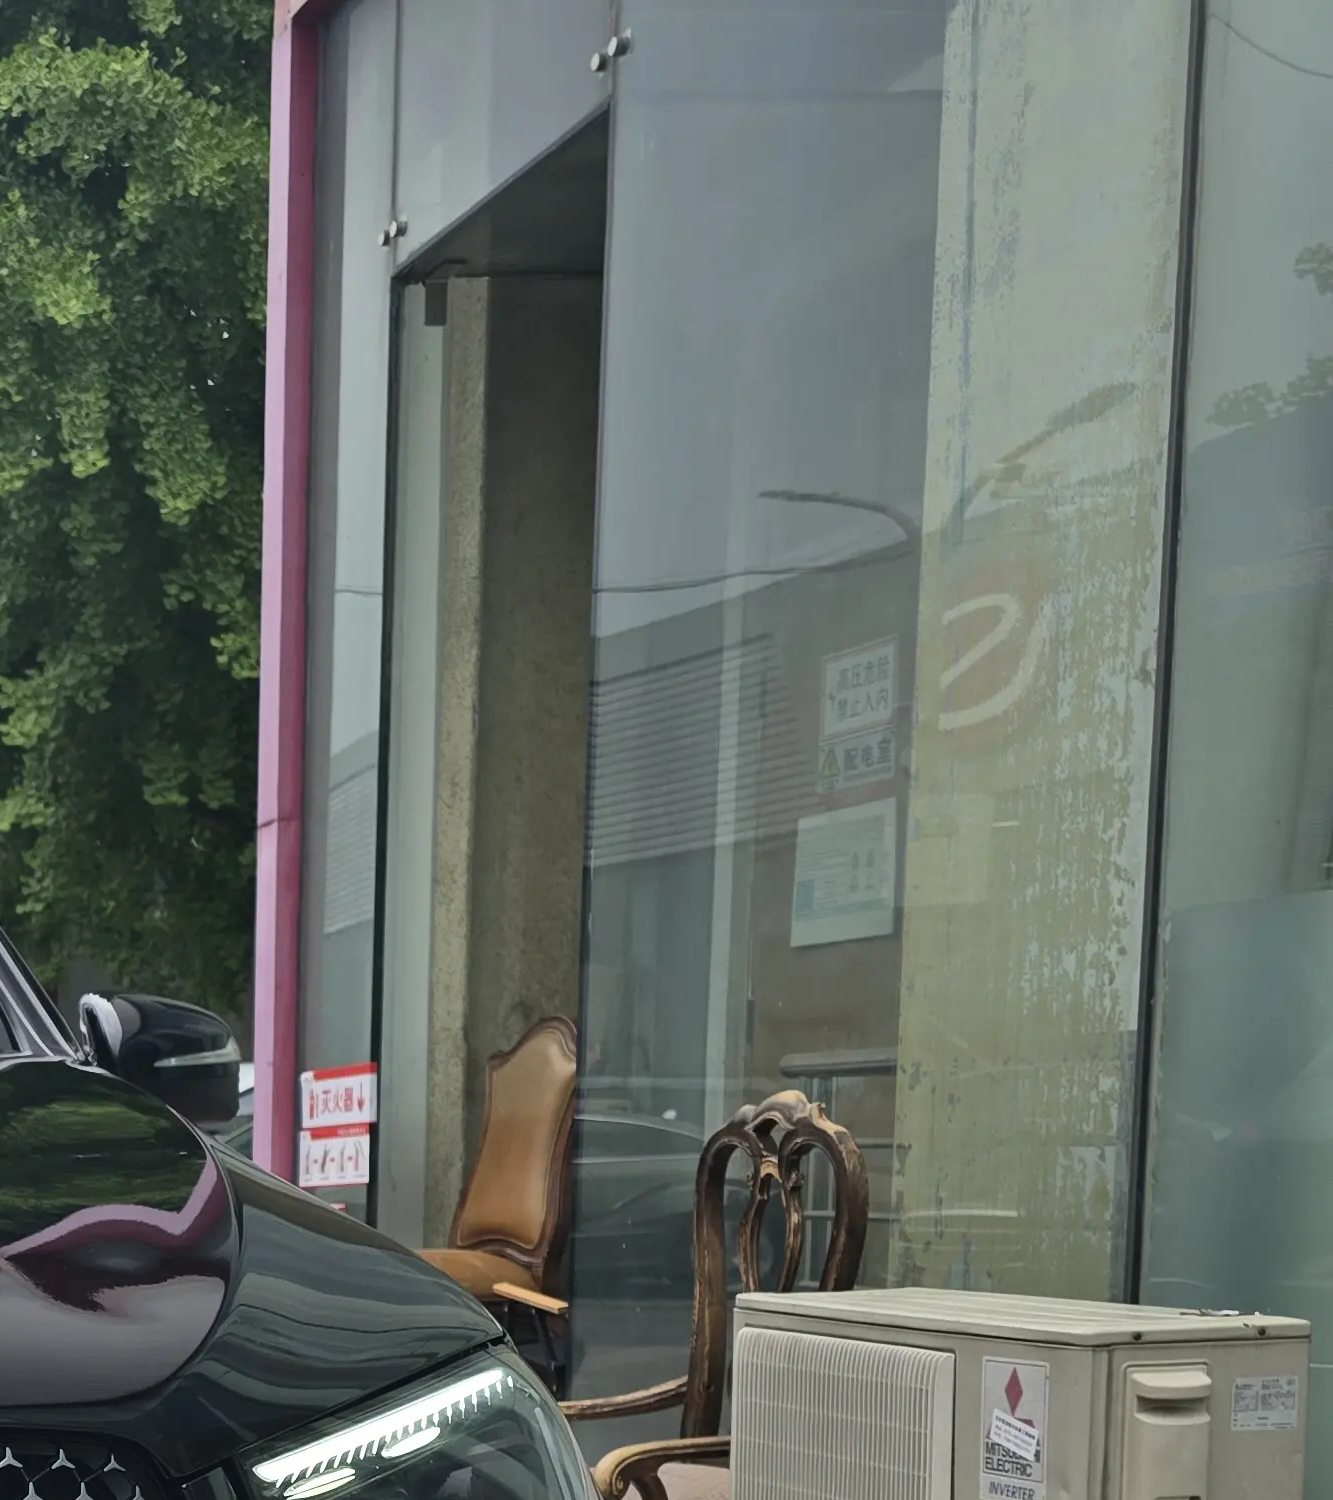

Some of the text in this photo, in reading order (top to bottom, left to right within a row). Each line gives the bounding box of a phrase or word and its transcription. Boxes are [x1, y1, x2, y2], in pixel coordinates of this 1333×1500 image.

[837, 655, 890, 692] 高压危险
[837, 687, 889, 722] 禁止入内
[843, 738, 892, 772] 配电室
[321, 1086, 354, 1115] 灭火器
[985, 1456, 1033, 1478] ELECTRIC
